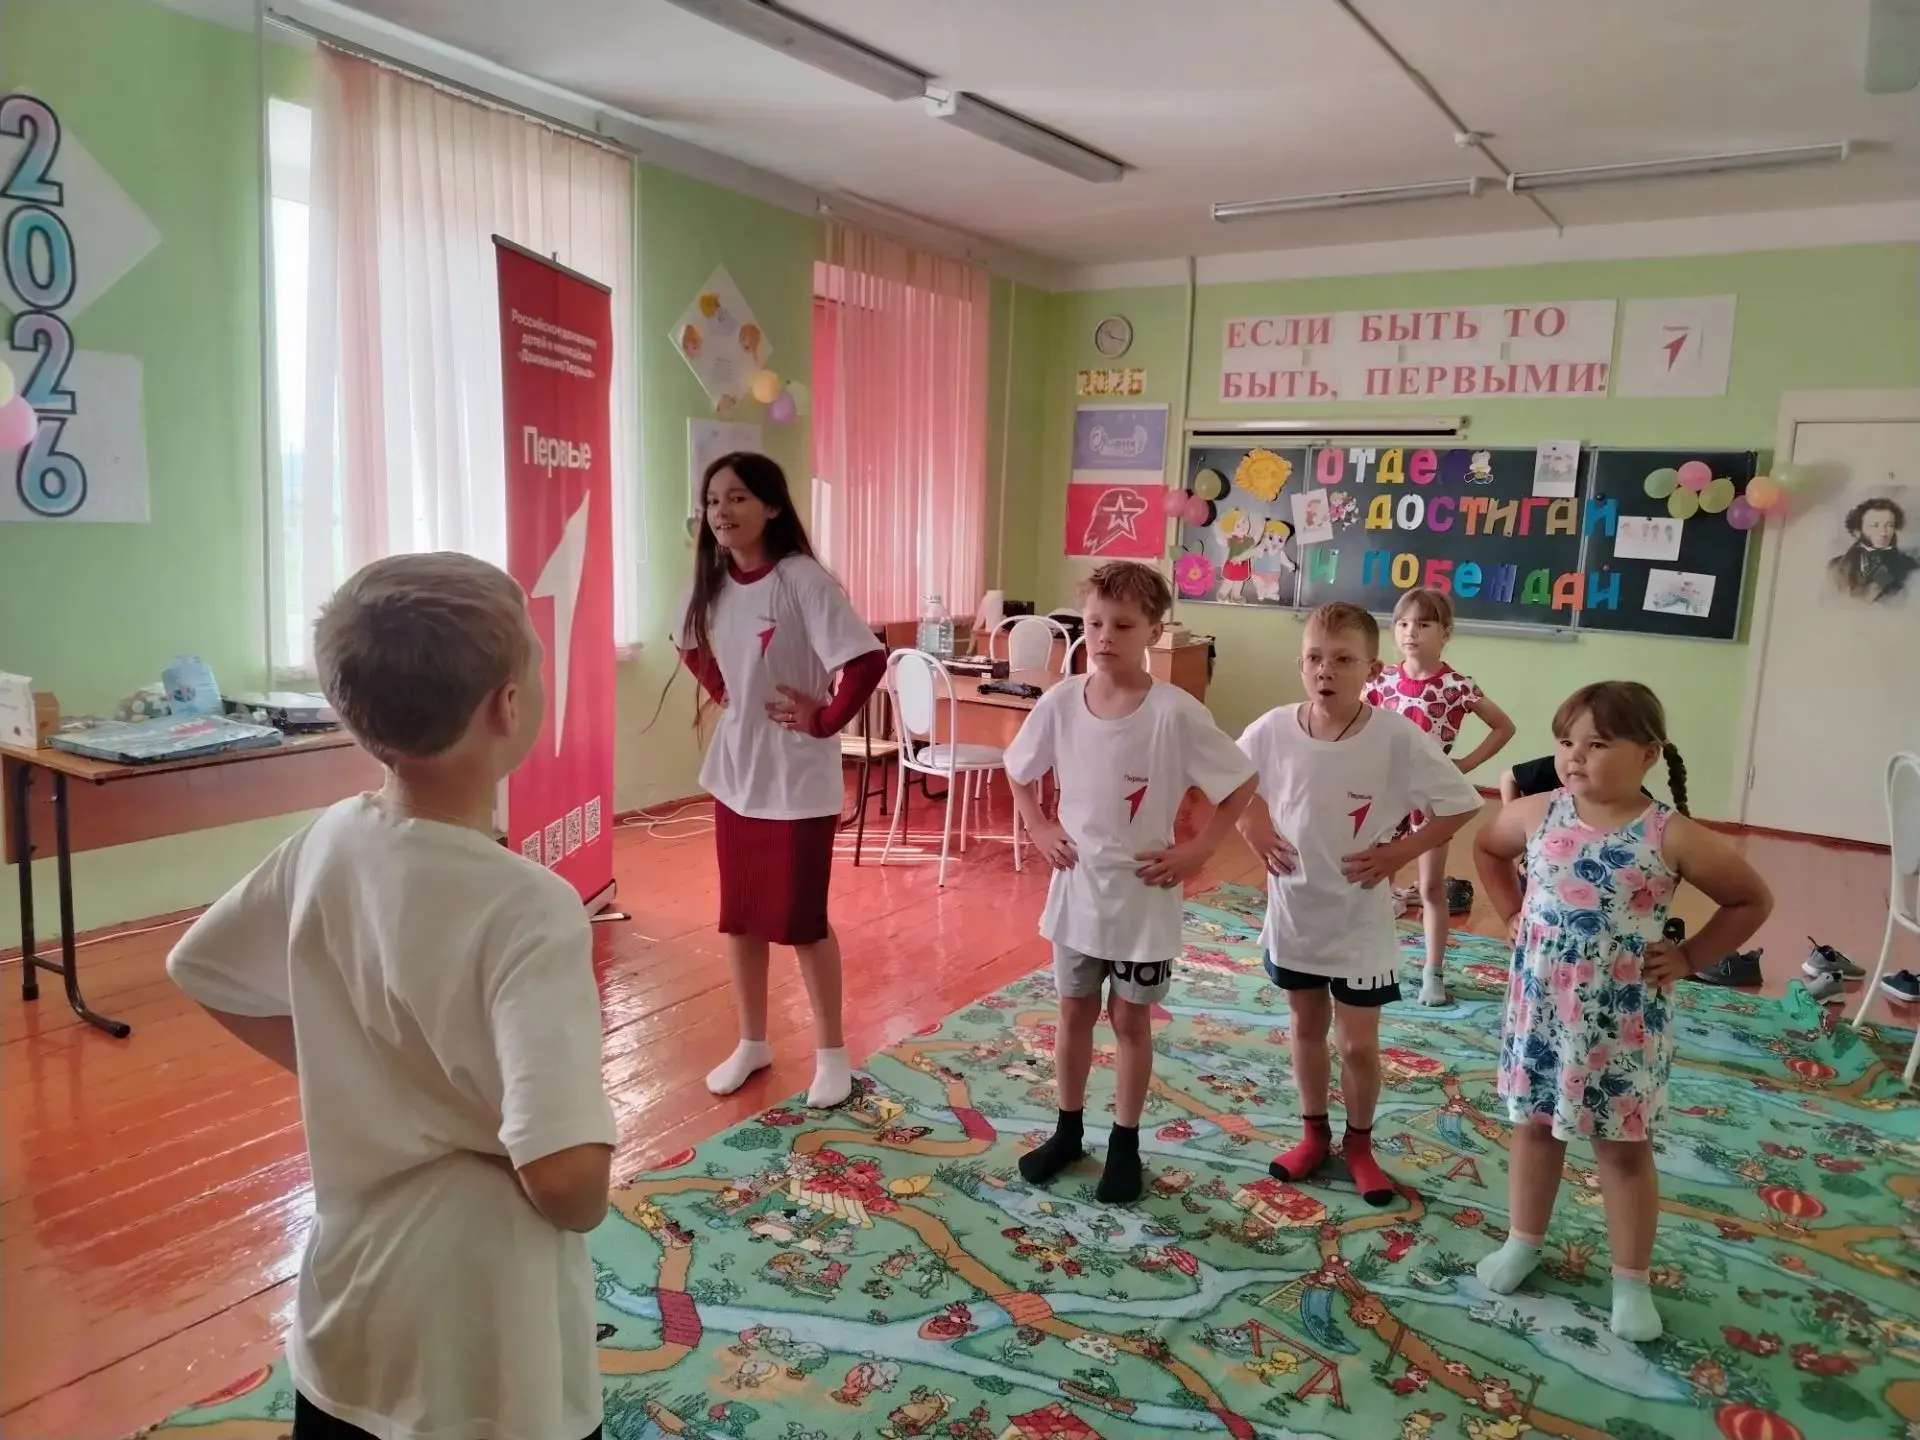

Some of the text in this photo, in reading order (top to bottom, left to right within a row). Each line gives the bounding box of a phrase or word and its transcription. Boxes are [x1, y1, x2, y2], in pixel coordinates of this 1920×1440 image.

[0, 94, 87, 517] 2026
[1226, 306, 1567, 349] ЕСЛИ БЫТЬ ТО
[1222, 363, 1610, 400] БЫТЬ, ПЕРВЫМИ!
[523, 425, 592, 478] Первые
